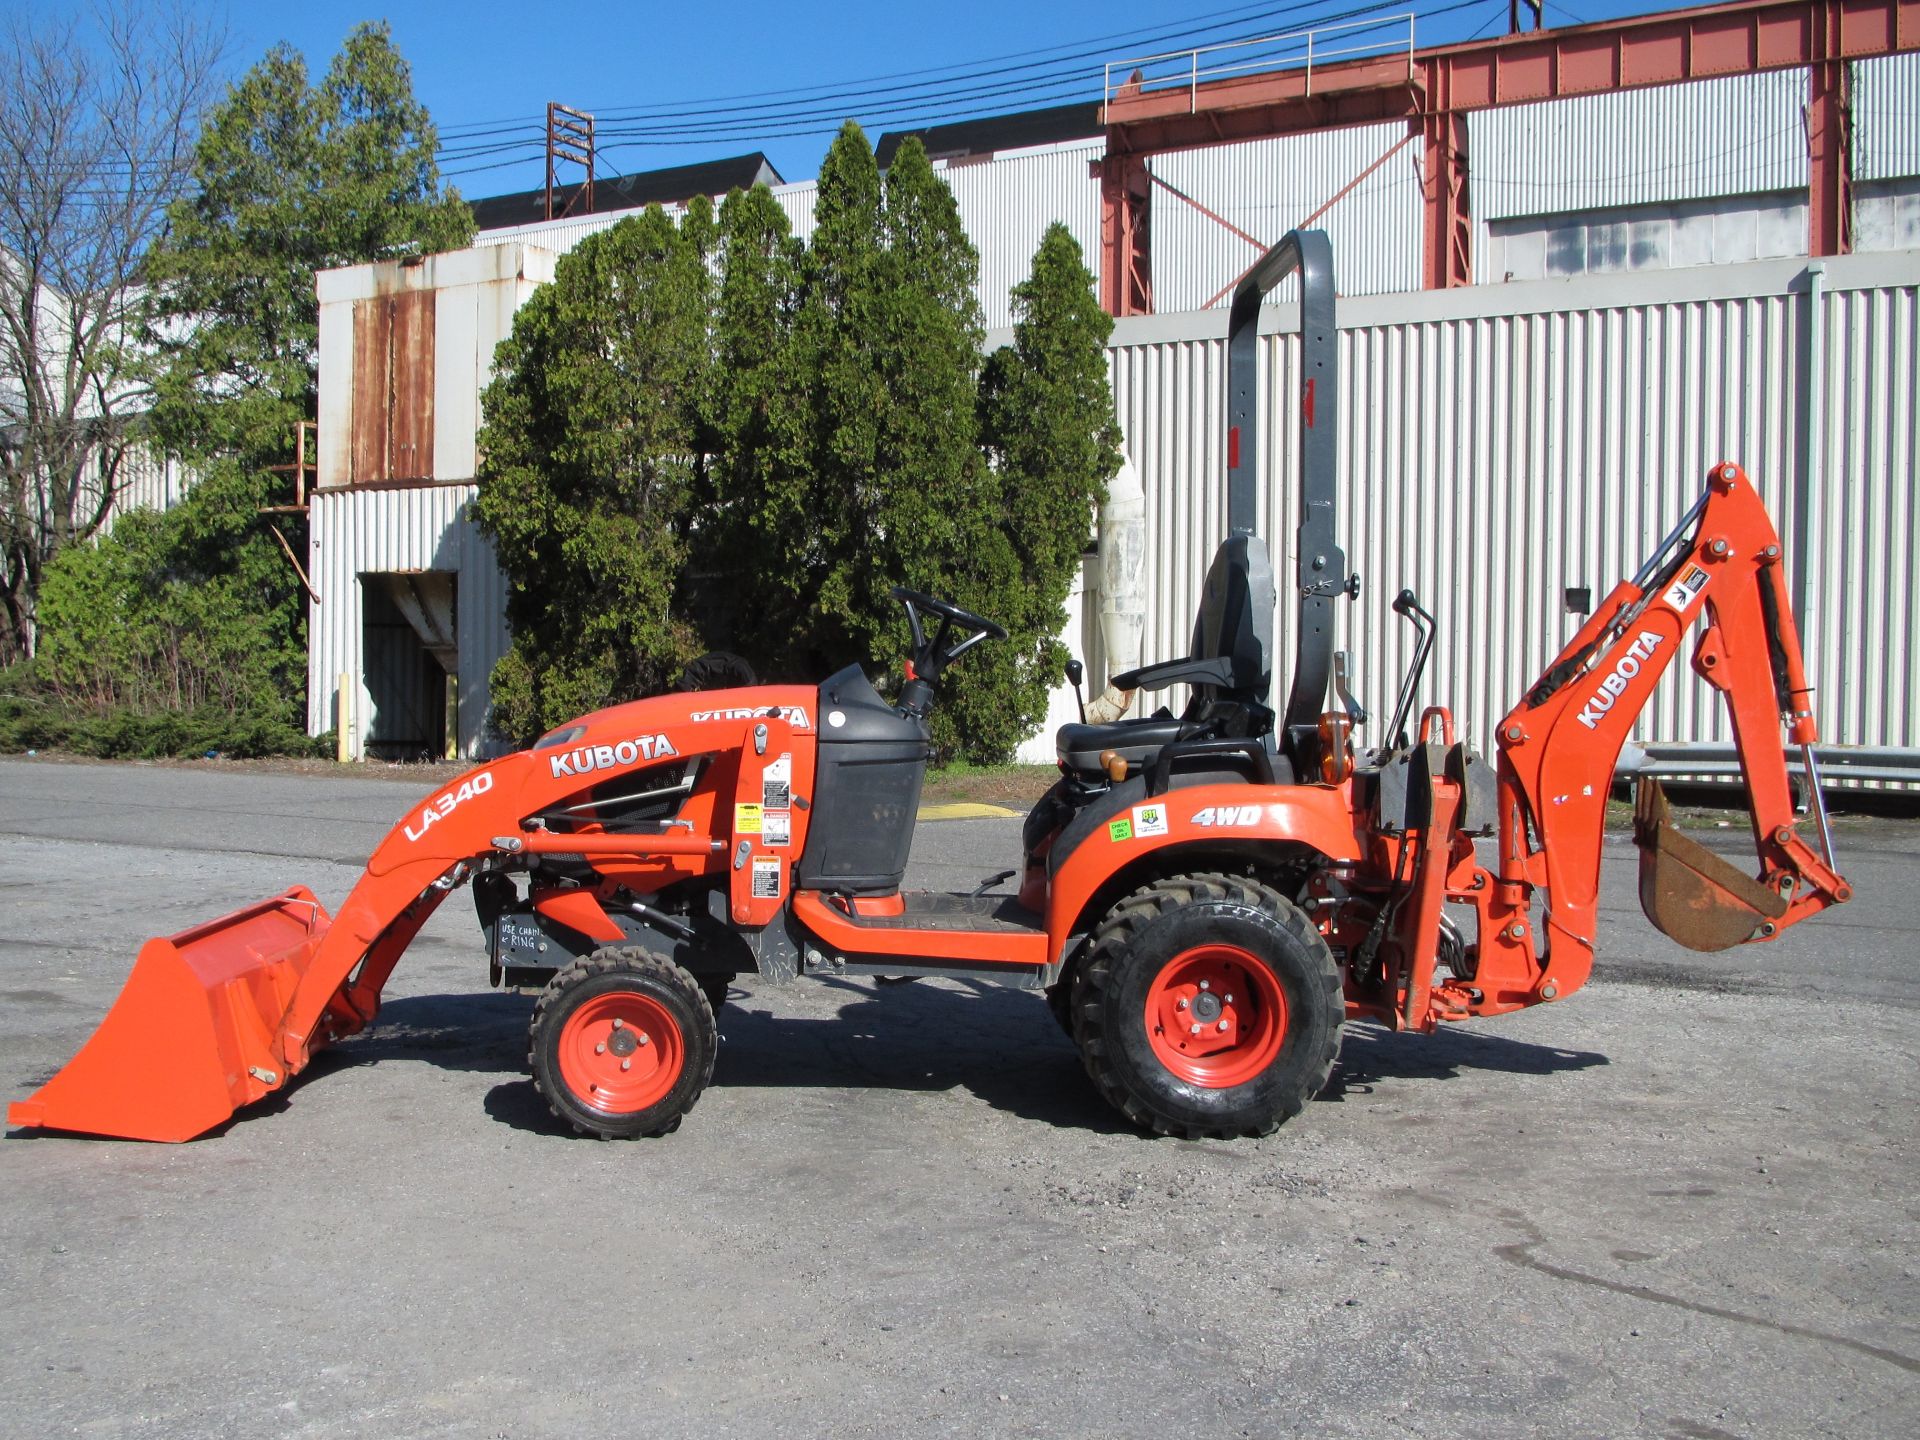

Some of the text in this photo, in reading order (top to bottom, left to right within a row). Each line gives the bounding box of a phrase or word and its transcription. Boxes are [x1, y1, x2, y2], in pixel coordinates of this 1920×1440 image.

[1576, 630, 1665, 730] KUBOTA
[549, 732, 678, 779] KUBOTA
[403, 771, 494, 842] LA340
[1142, 809, 1157, 820] 811
[1190, 806, 1262, 827] 4WD
[1111, 822, 1128, 830] CHECK
[501, 924, 516, 934] USE
[510, 934, 535, 949] RING
